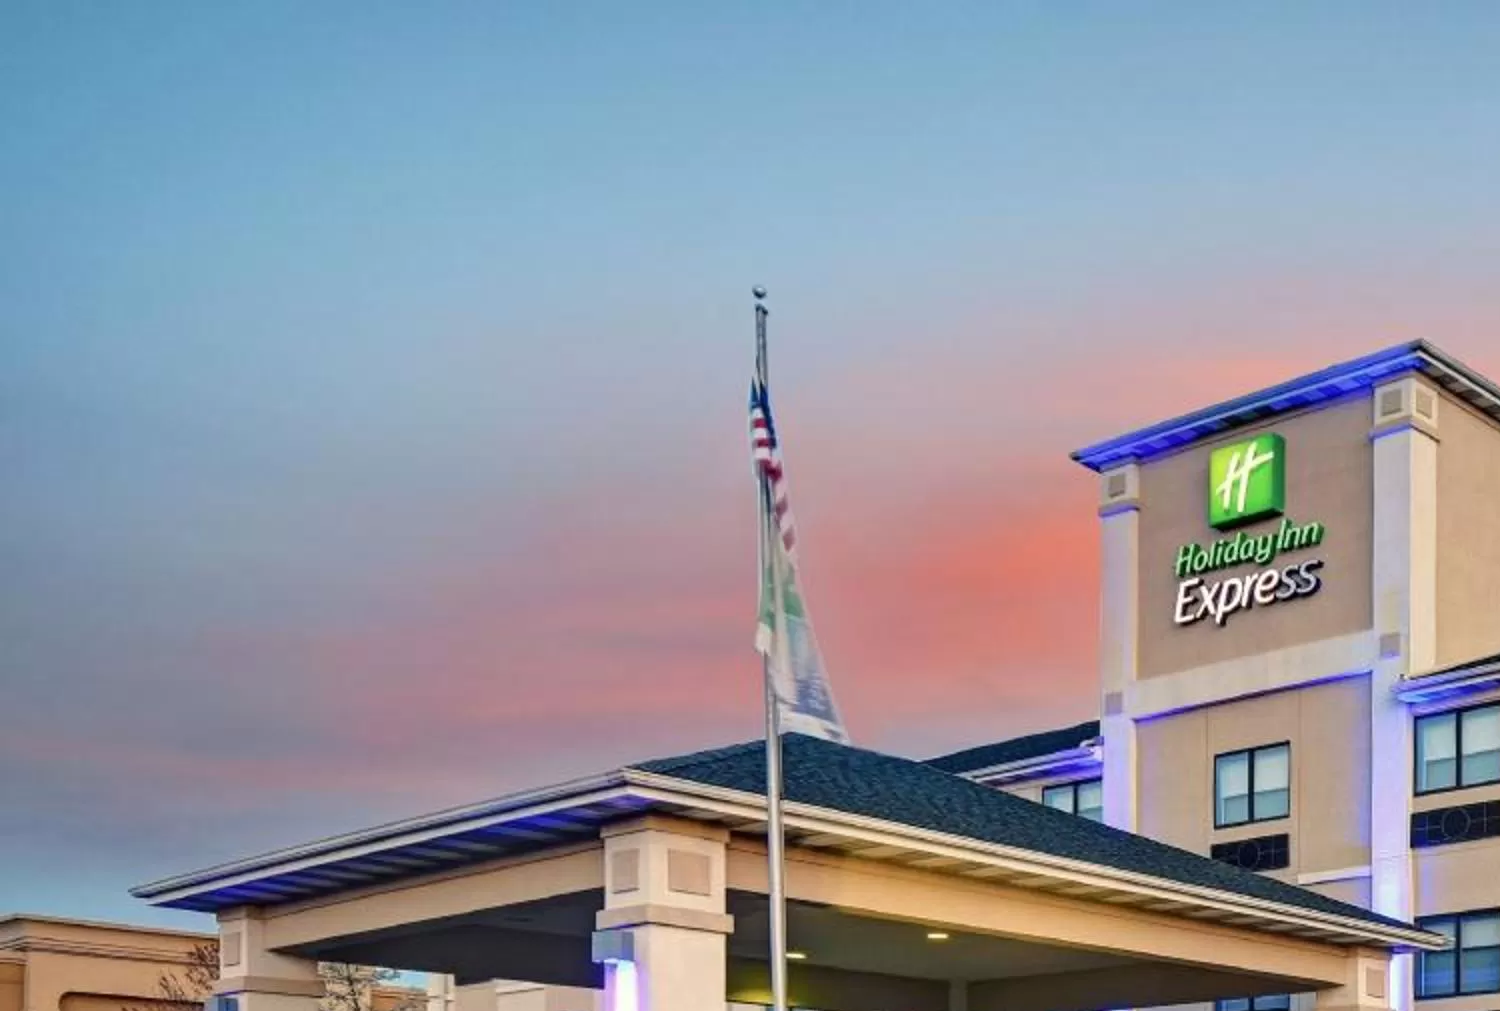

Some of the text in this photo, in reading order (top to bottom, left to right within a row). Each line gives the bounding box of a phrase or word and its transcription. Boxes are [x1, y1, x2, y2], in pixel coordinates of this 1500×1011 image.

[1175, 519, 1322, 577] Holiday Inn
[1174, 559, 1322, 625] Express
